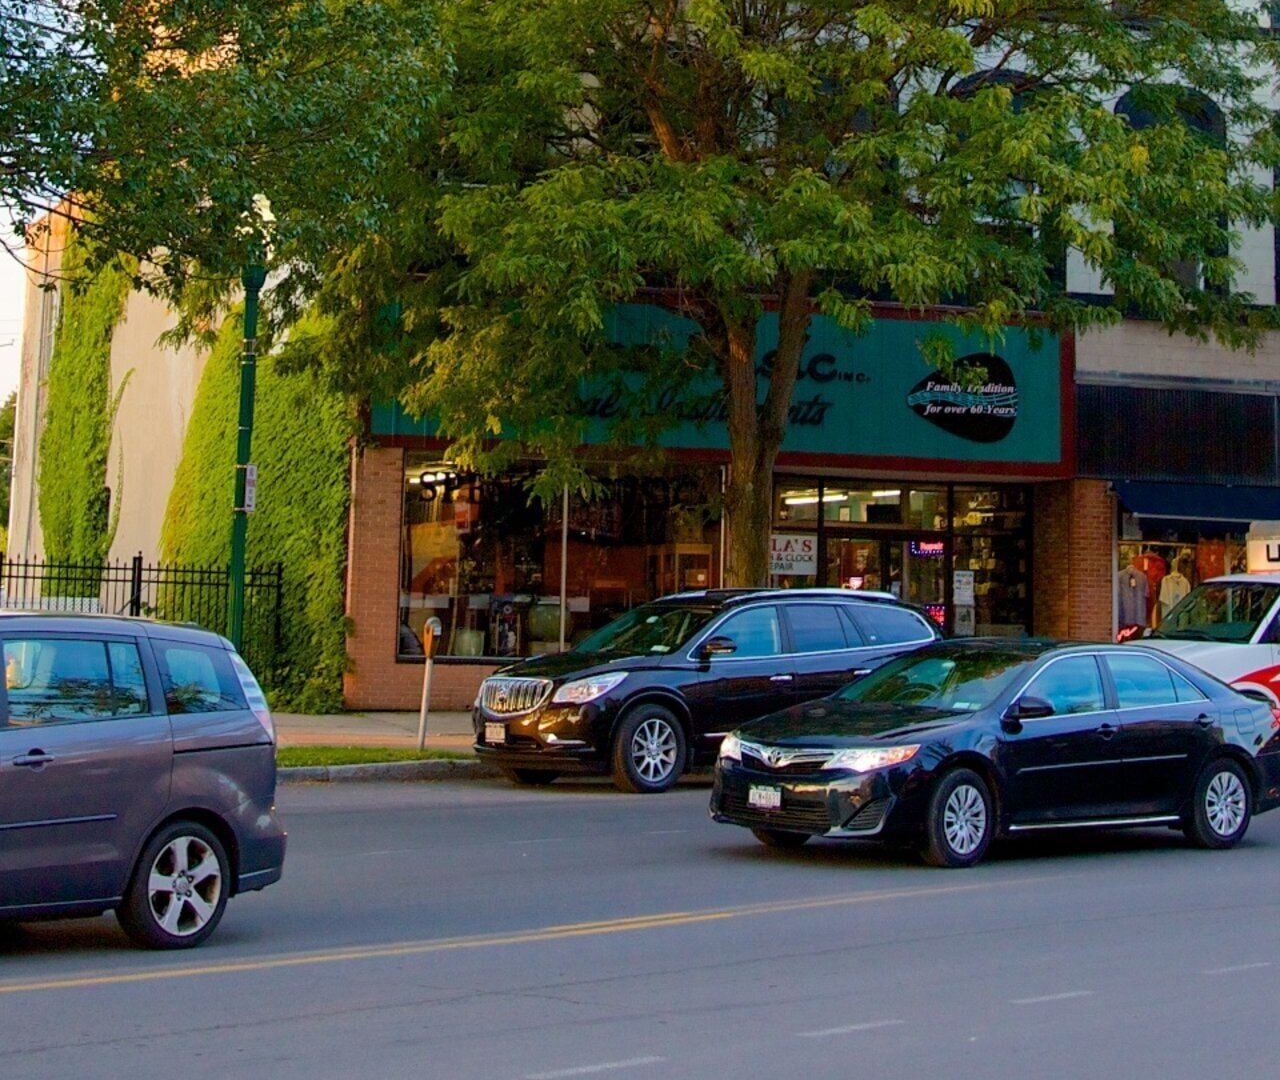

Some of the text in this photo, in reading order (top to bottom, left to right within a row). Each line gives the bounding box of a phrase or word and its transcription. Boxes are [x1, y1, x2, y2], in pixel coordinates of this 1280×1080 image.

[925, 380, 962, 394] Family
[923, 404, 942, 416] for
[943, 405, 967, 415] over
